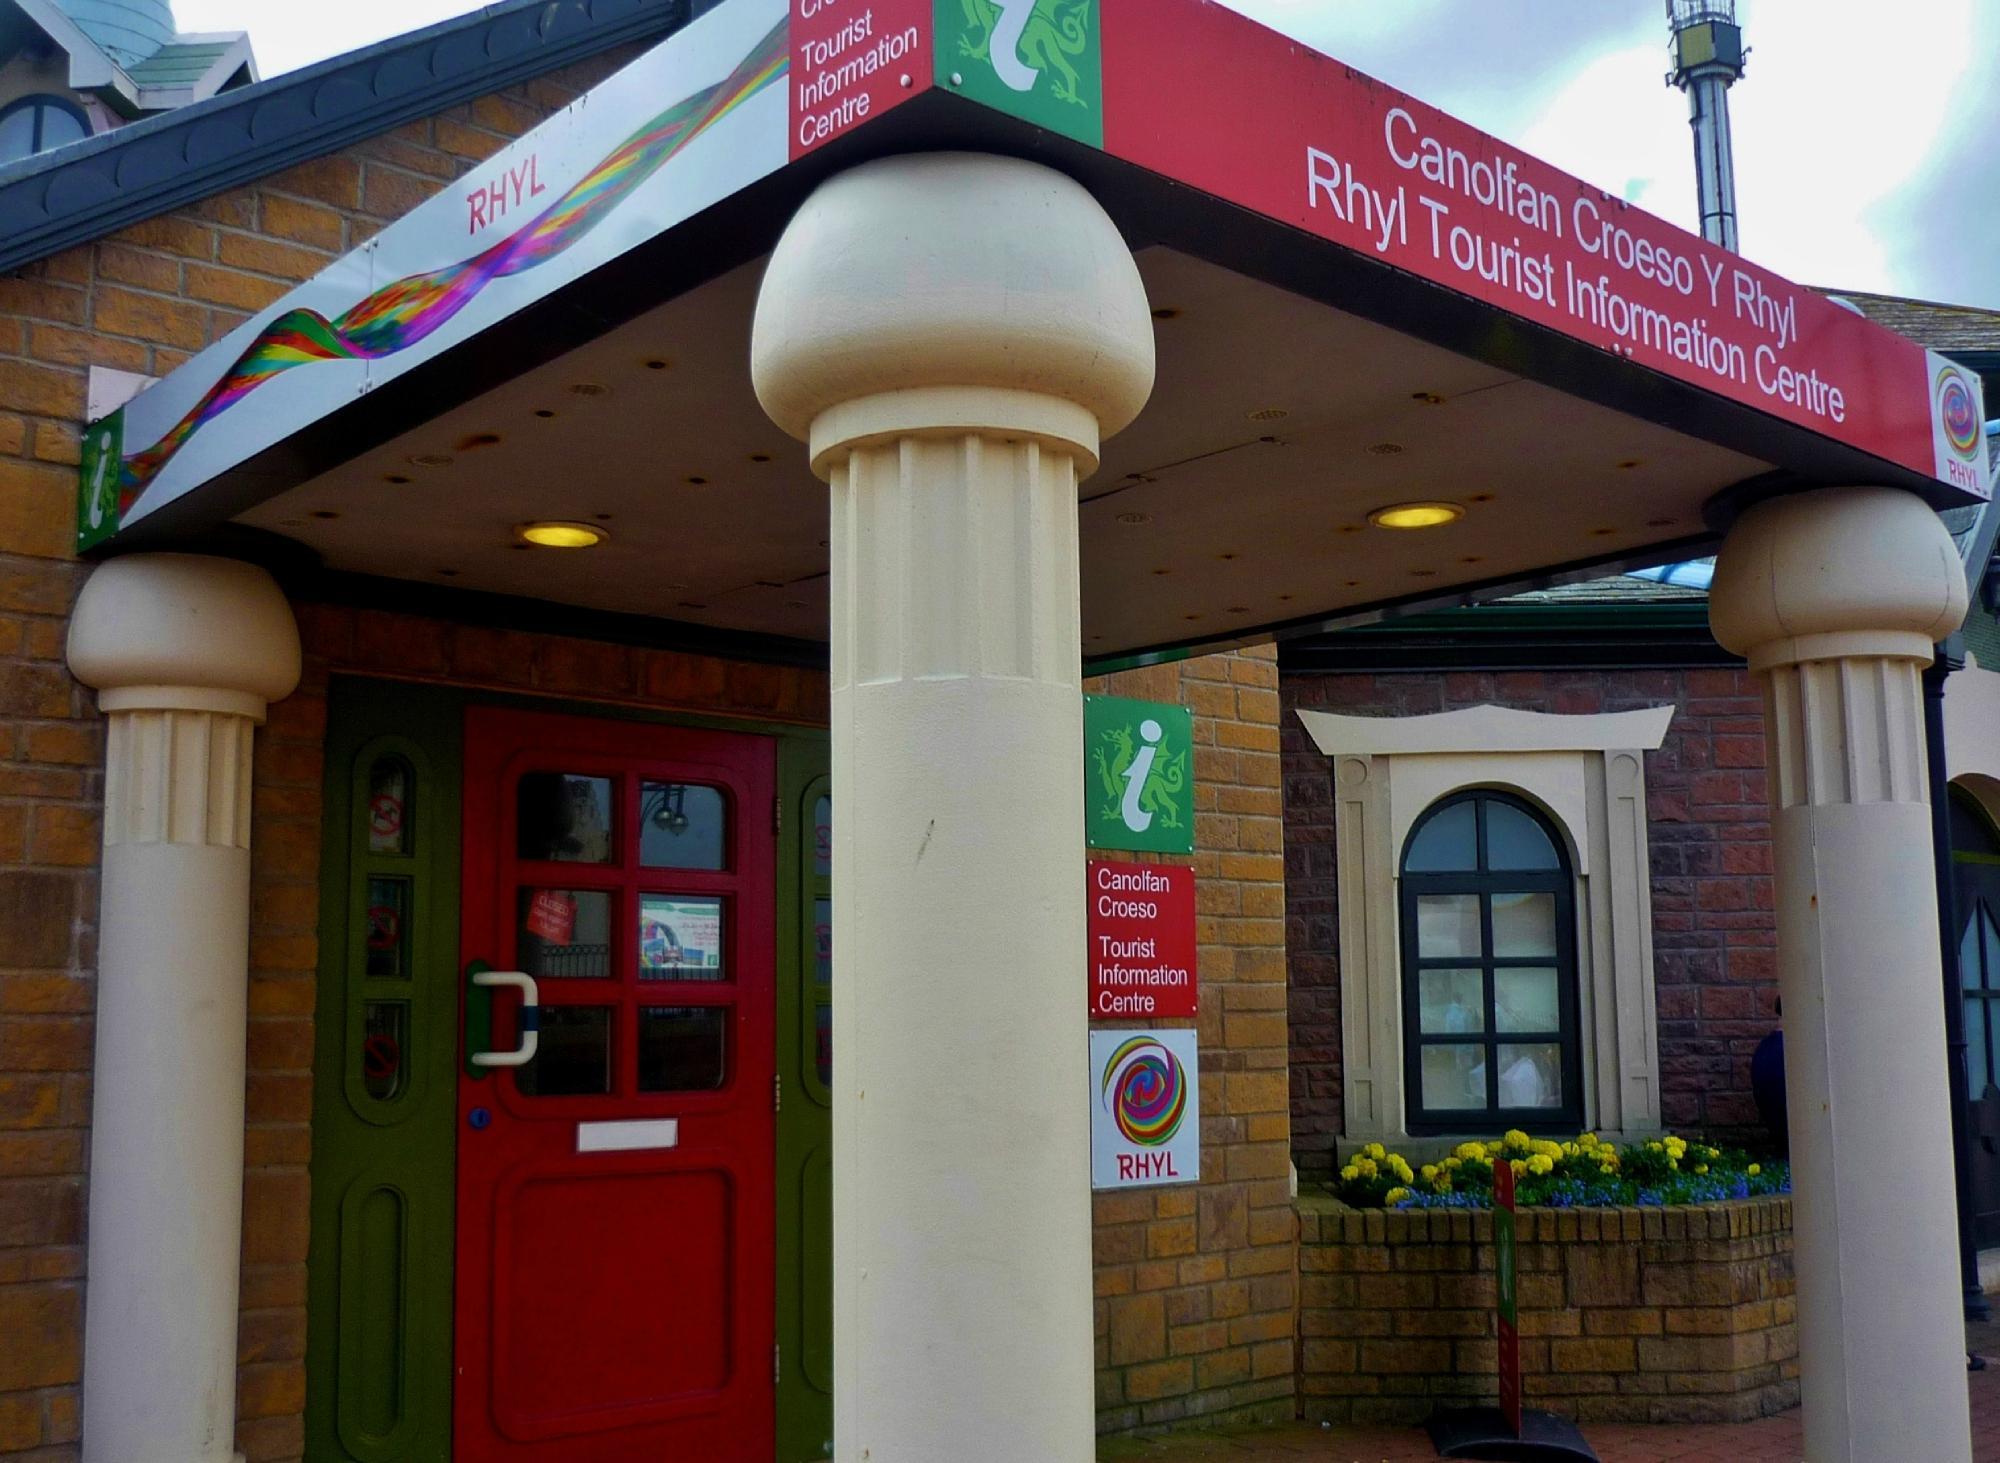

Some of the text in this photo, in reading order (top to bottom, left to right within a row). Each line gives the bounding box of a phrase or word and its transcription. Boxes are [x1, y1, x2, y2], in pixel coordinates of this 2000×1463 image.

[800, 8, 872, 72] Tourist
[800, 26, 918, 112] Information
[800, 92, 870, 146] Centre
[466, 153, 546, 236] RHYL
[1384, 108, 1797, 350] Canolfan Croeso Y Rhyl
[1307, 146, 1846, 424] Rhyl Tourist Information Centre
[1947, 458, 1980, 492] RHYL
[1098, 868, 1170, 893] Canolfan
[1098, 895, 1157, 919] Croeso
[1099, 935, 1156, 958] Tourist
[1099, 963, 1188, 986] Information
[1099, 990, 1155, 1013] Centre
[1116, 1151, 1179, 1180] RHYL
